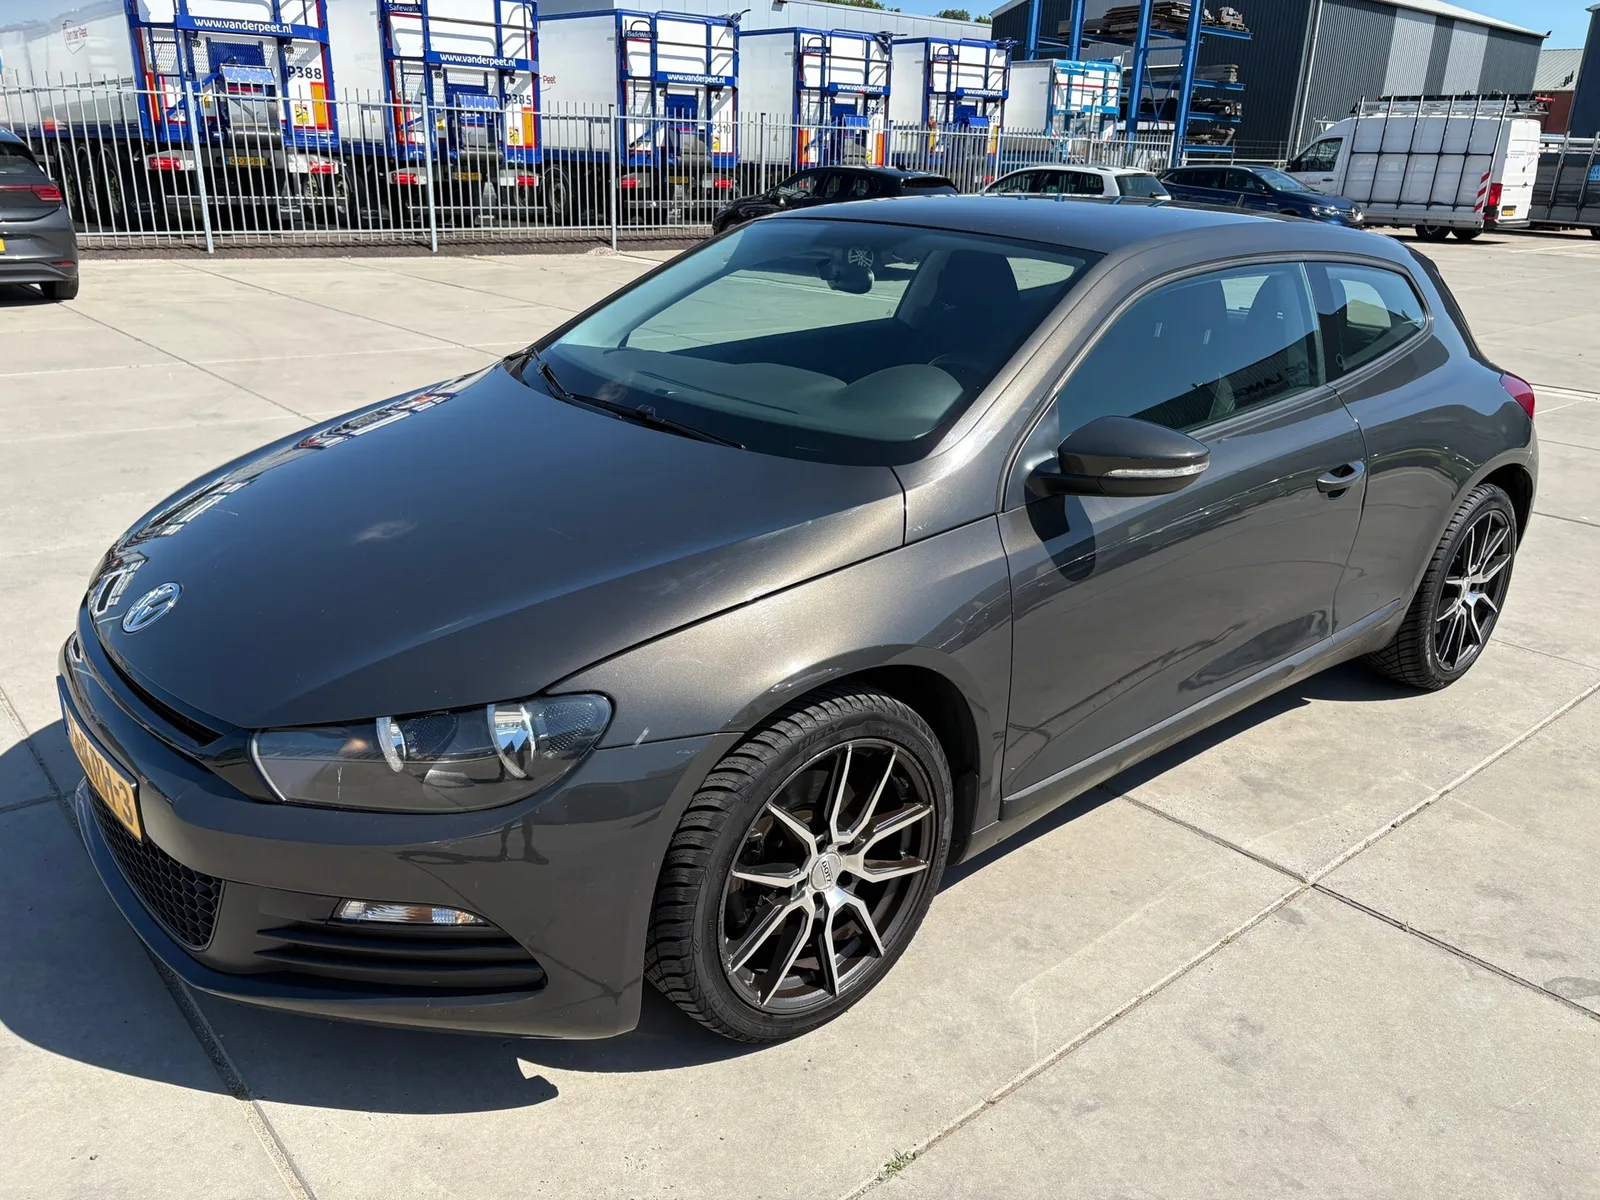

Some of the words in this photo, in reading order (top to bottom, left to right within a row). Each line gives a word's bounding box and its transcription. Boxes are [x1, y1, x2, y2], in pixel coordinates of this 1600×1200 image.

[194, 18, 293, 34] www.vanderpeet.nl
[440, 53, 517, 67] www.vanderpeet.nl
[287, 65, 322, 80] P388
[667, 73, 726, 84] www.vanderpeet.nl
[837, 83, 884, 93] www.vanderpeet.nl
[505, 93, 532, 105] P385
[712, 123, 731, 134] P310
